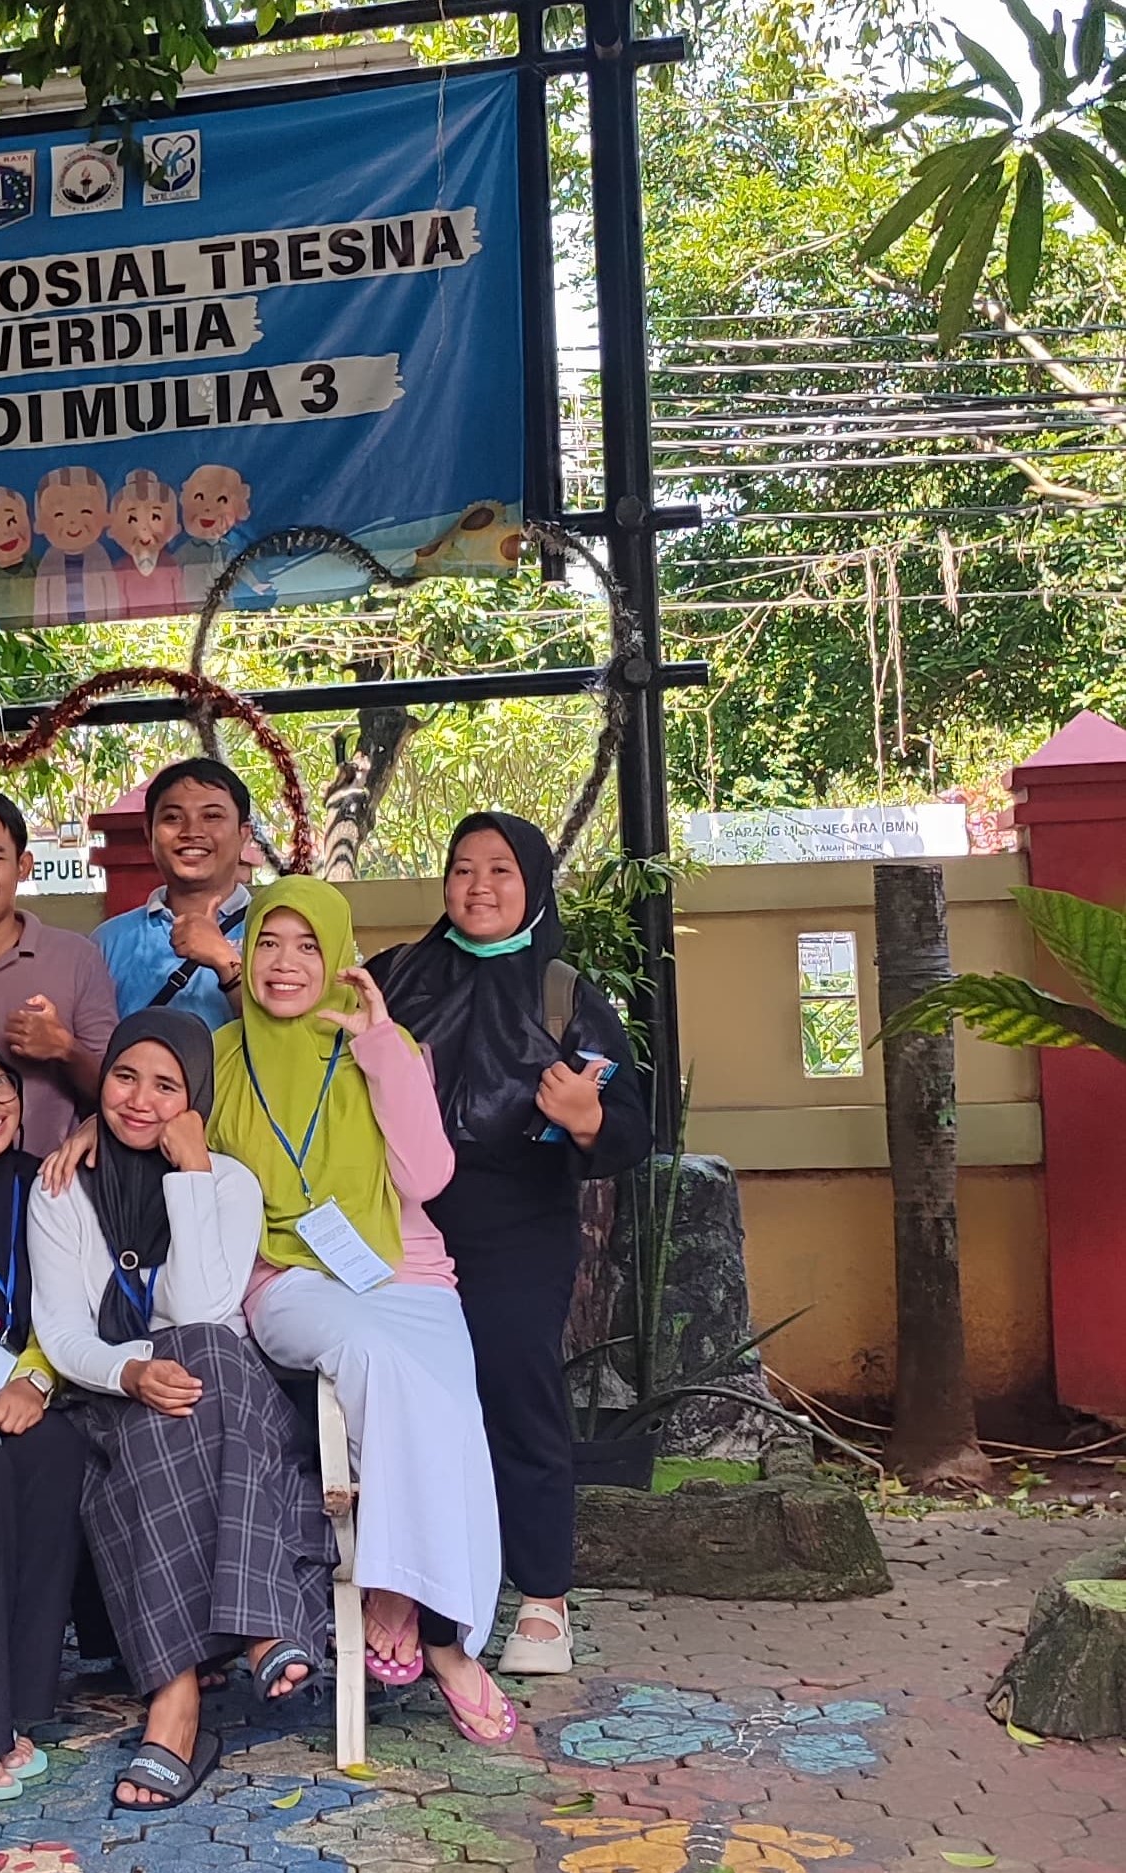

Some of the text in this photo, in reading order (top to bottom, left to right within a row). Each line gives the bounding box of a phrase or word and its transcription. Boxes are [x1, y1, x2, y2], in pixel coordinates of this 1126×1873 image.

[199, 216, 465, 290] TRESNA
[63, 370, 284, 440] MULIA
[300, 364, 339, 414] 3
[823, 821, 878, 835] NEGARA
[881, 820, 920, 834] (BMN)
